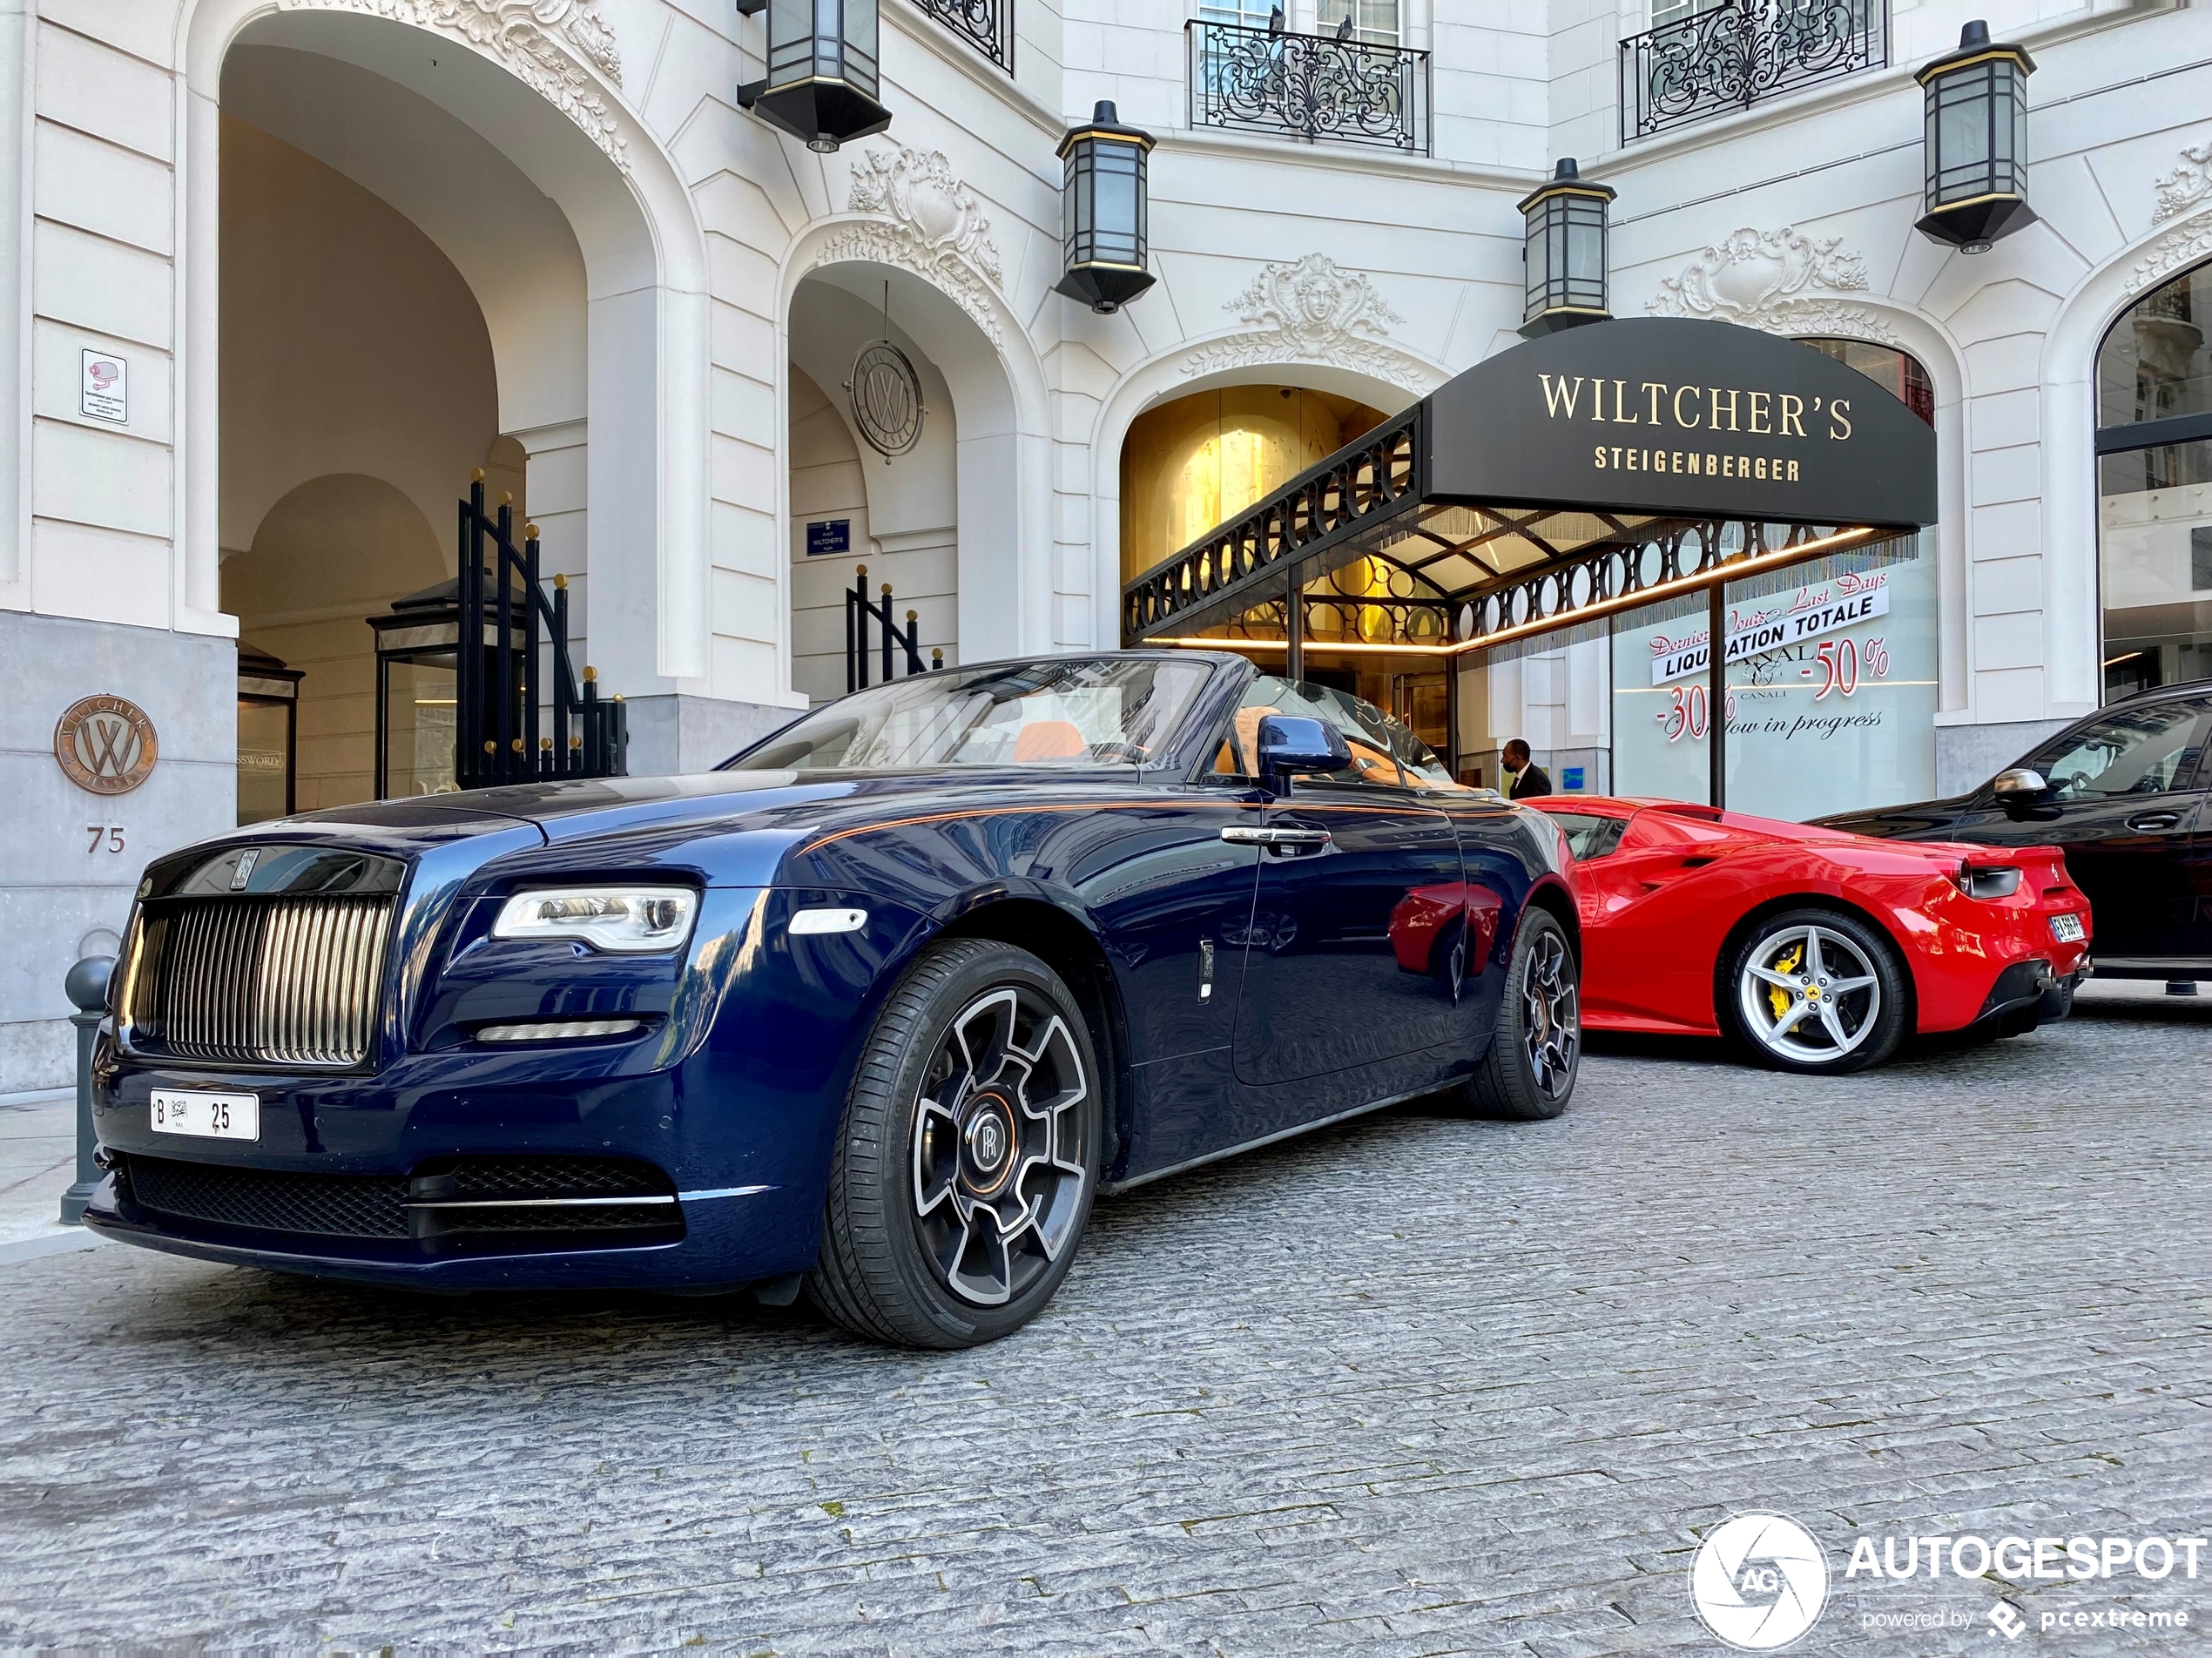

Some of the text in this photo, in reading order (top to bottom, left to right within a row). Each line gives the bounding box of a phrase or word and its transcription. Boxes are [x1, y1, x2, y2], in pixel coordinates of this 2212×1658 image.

[1538, 374, 1852, 441] WILTCHER'S
[1595, 446, 1800, 482] STEIGENBERGER
[1788, 587, 1831, 614] Last
[1837, 571, 1887, 596] Days
[1796, 596, 1874, 637] TOTALE
[1741, 691, 1786, 700] CANALI
[1764, 717, 1790, 732] in
[1786, 711, 1882, 740] progress
[87, 826, 125, 853] 75
[157, 1098, 165, 1124] B
[212, 1103, 230, 1129] 25
